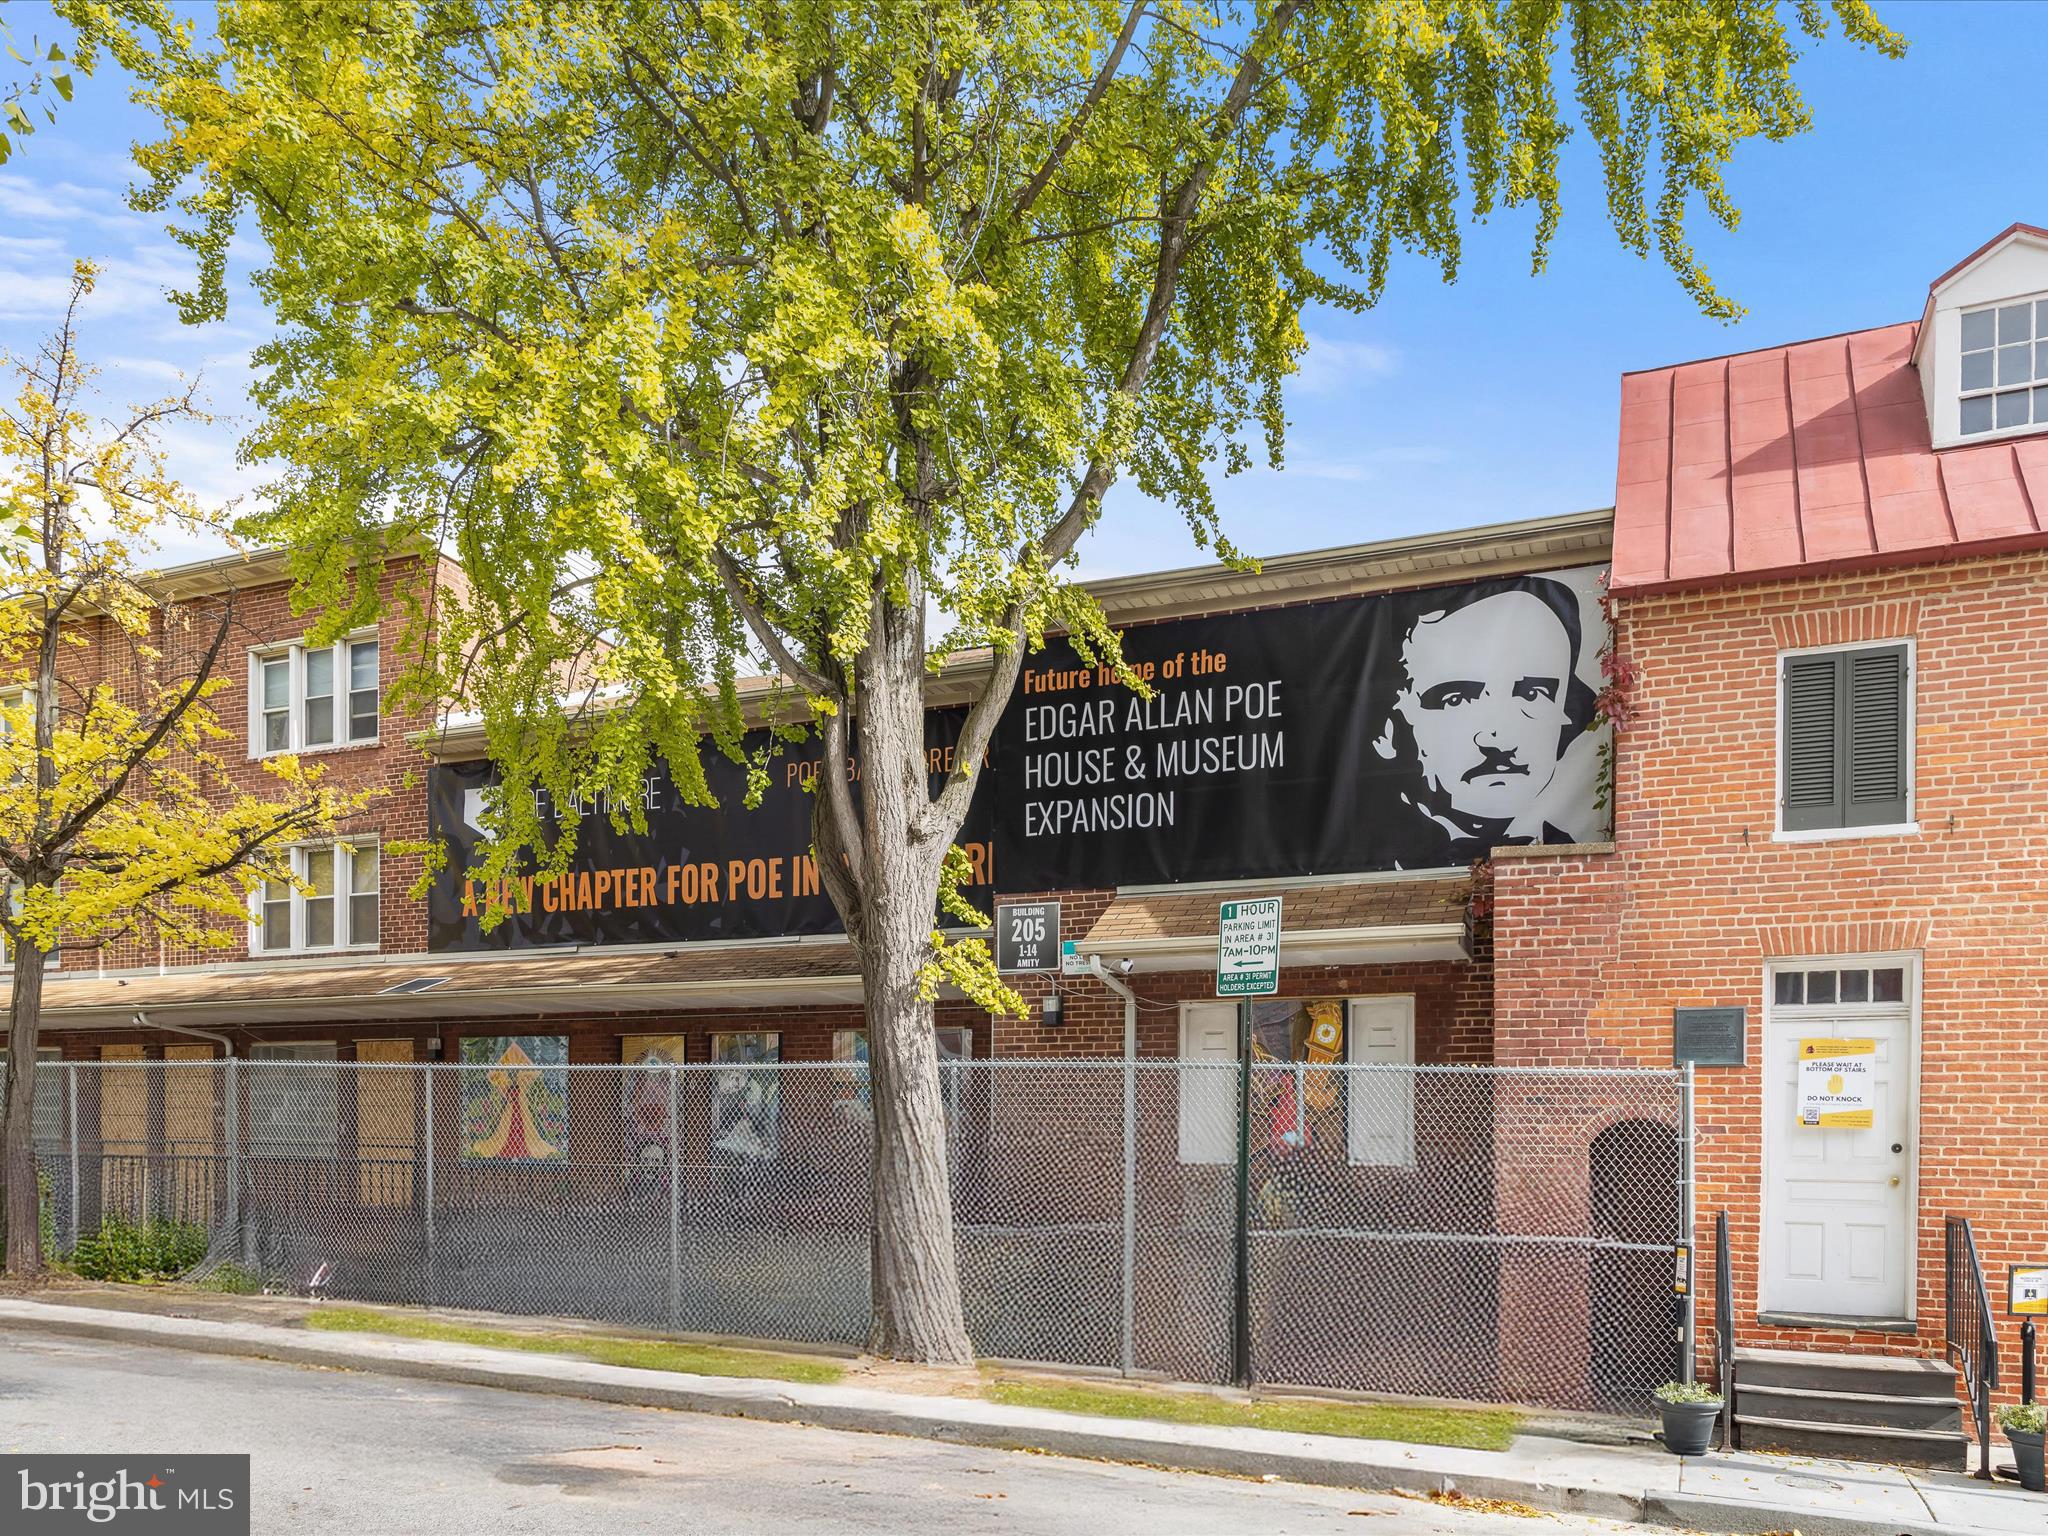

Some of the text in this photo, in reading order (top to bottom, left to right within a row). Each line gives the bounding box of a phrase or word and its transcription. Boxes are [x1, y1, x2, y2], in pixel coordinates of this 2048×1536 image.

[1024, 667, 1090, 694] Future
[1162, 653, 1184, 679] of
[1191, 649, 1227, 676] the
[1025, 680, 1282, 742] EDGAR ALLAN POE
[1025, 747, 1115, 789] HOUSE
[1124, 745, 1146, 781] &
[1156, 731, 1284, 778] MUSEUM
[1025, 790, 1174, 837] EXPANSION
[542, 867, 657, 912] CHAPTER
[667, 863, 719, 905] FOR
[728, 857, 783, 901] POE
[792, 855, 820, 897] IN
[1012, 907, 1045, 917] BUILDING
[1227, 902, 1275, 918] 1 HOUR
[1011, 918, 1046, 942] 205
[1223, 919, 1276, 932] PARKING LIMIT
[1224, 932, 1274, 944] IN AREA # 31
[1019, 944, 1037, 956] 1-14
[1222, 945, 1276, 957] 7AM-10PM
[1017, 959, 1040, 968] AMITY
[1223, 974, 1238, 982] AREA
[1252, 972, 1273, 980] PERMIT
[1219, 981, 1274, 991] HOLDERS EXCEPTED
